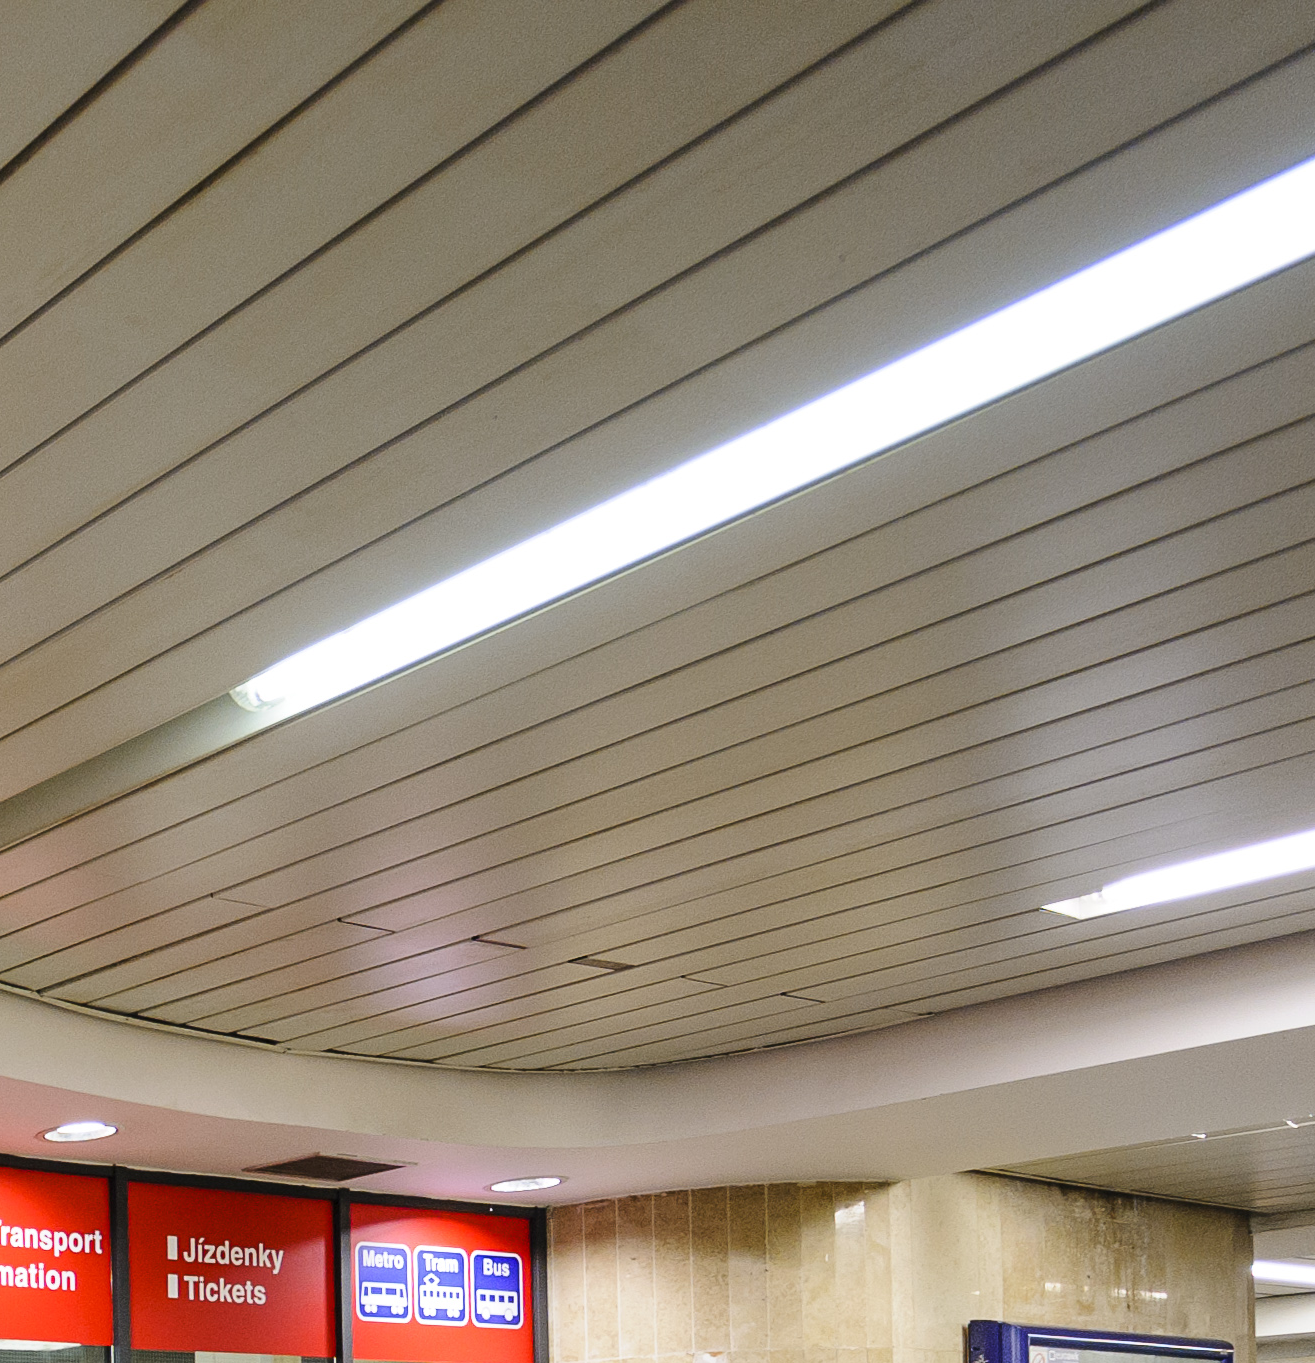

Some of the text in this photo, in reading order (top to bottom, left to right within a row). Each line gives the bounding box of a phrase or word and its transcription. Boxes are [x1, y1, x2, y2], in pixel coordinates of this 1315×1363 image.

[183, 1236, 284, 1275] Jízdenky
[362, 1249, 404, 1269] Metro
[422, 1253, 459, 1274] Tram
[482, 1258, 510, 1277] Bus
[184, 1275, 267, 1305] Tickets
